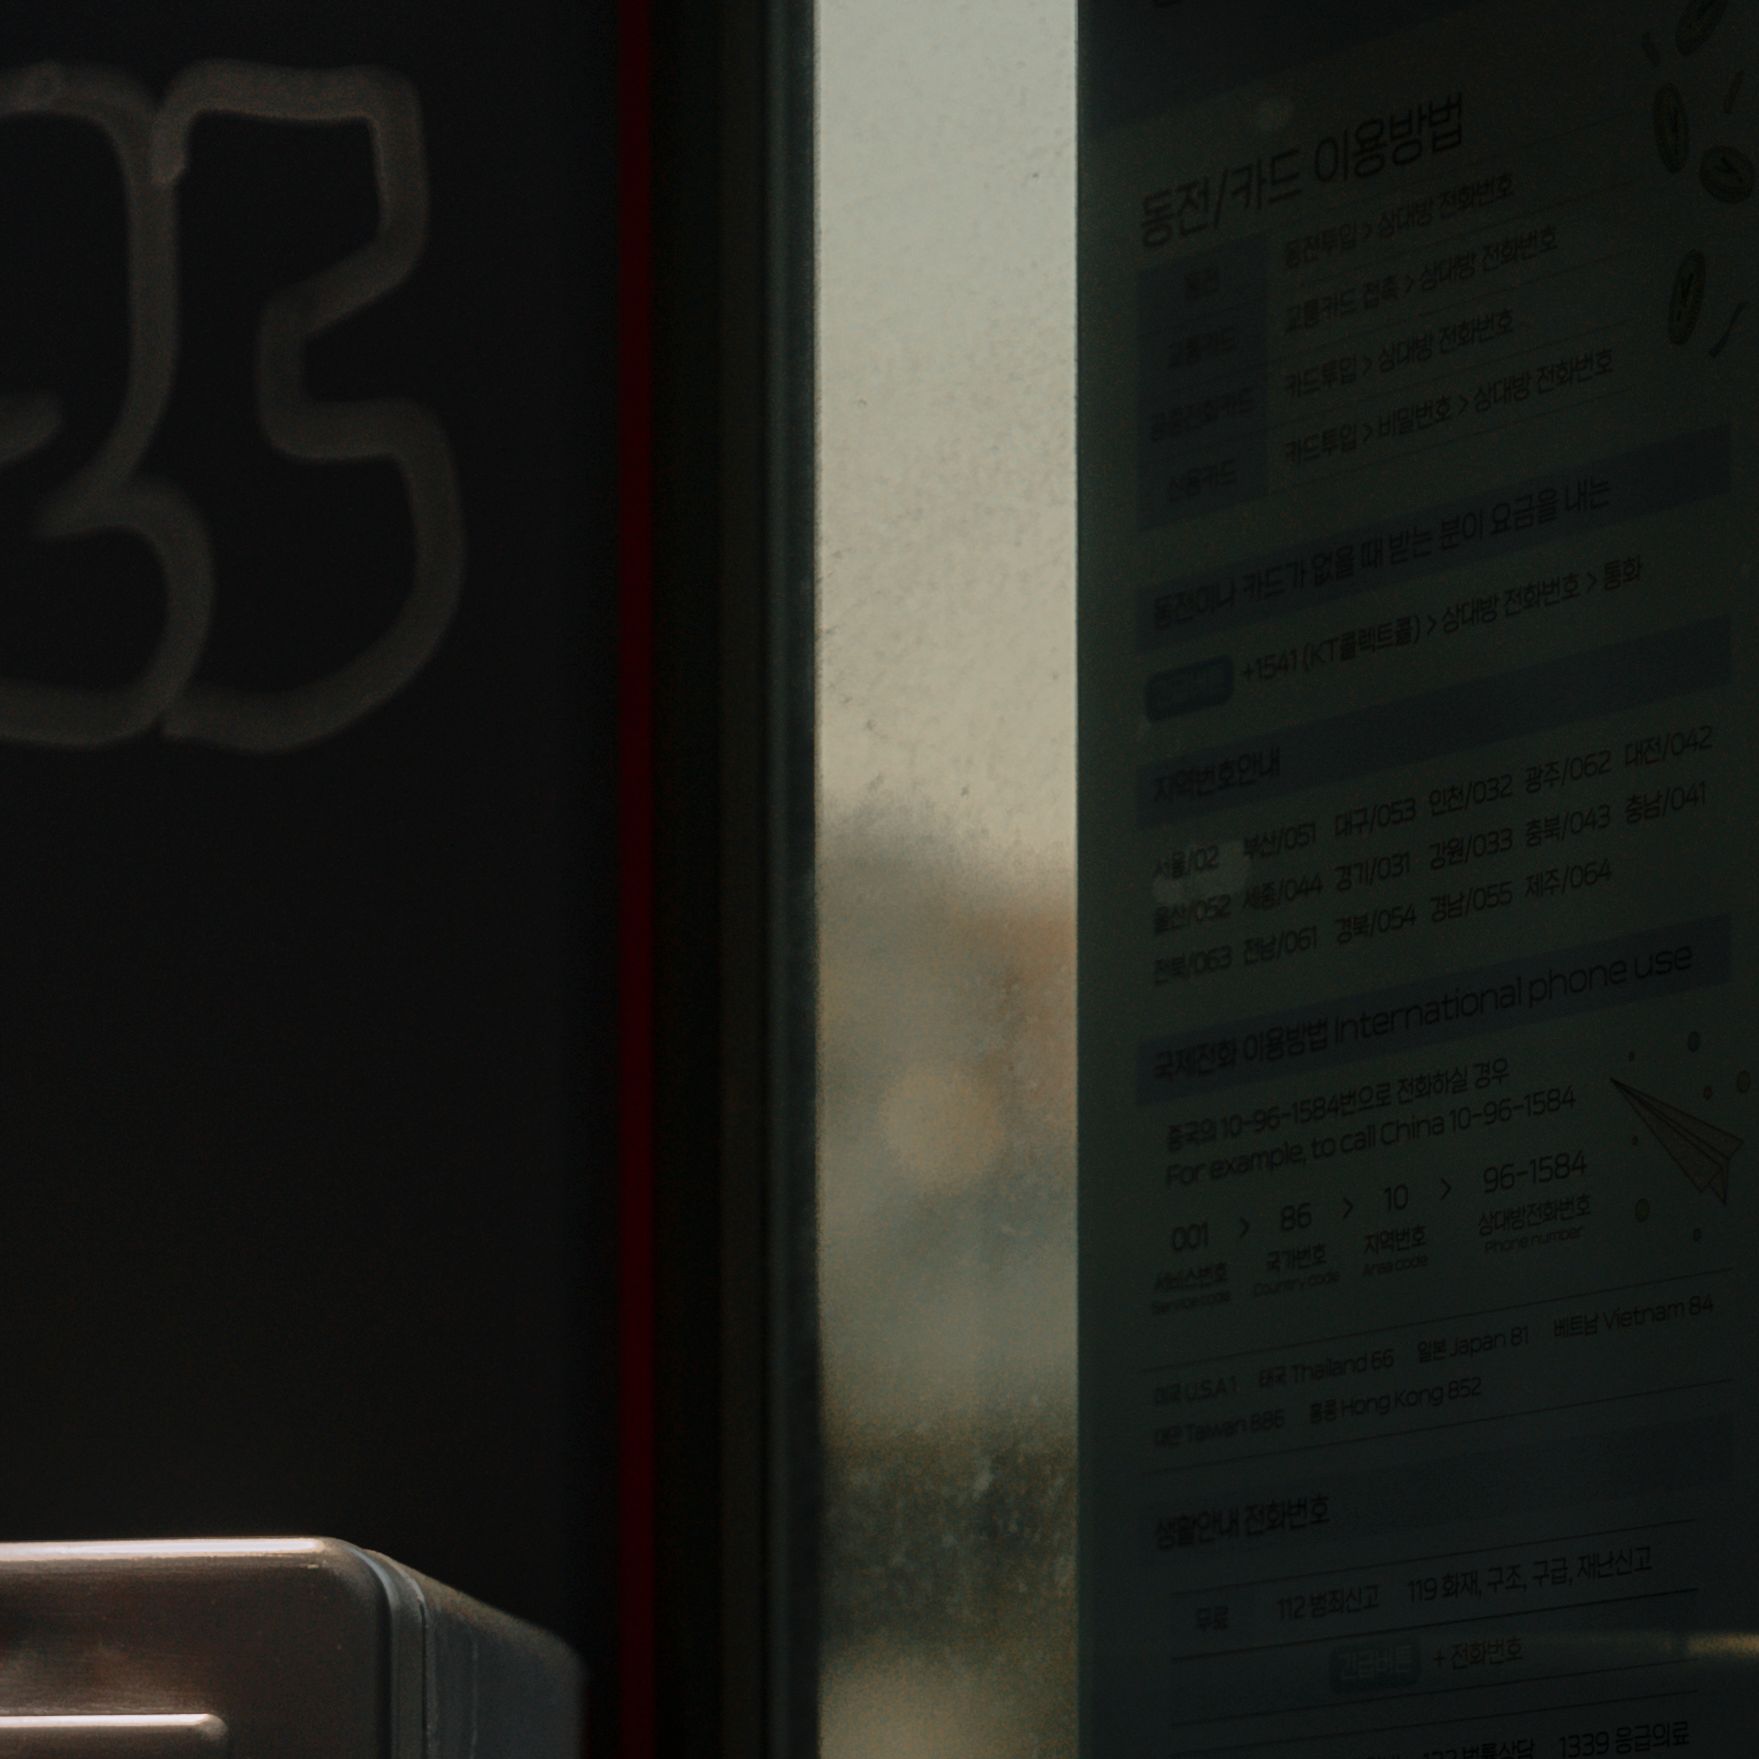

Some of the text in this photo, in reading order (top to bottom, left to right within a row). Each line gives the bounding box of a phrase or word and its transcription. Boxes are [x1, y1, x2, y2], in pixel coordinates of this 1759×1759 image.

[1313, 91, 1463, 183] 이용방법
[1377, 200, 1434, 239] 상대방
[1440, 172, 1515, 220] 전화번호
[1418, 225, 1559, 293] 상대방 전화번호
[1377, 335, 1434, 374] 상대방
[1440, 309, 1515, 353] 전화번호
[1377, 396, 1452, 438] 비밀번호
[1473, 376, 1532, 414] 상대방
[1535, 348, 1614, 394] 전화번호
[1242, 476, 1612, 603] 카드가 없을 때 받는 분이 요금을 내는
[1442, 554, 1643, 634] 상대방 전화번호 통화
[1335, 798, 1417, 838] 대구/053
[1429, 773, 1514, 817] 인천/032
[1525, 750, 1612, 794] 광주/062
[1625, 725, 1714, 767] 대전/042
[1429, 827, 1514, 871] 강원/033
[1525, 858, 1613, 899] 제주/064
[1242, 1018, 1329, 1063] 이용방법
[1334, 974, 1524, 1045] International
[1528, 960, 1628, 1007] phone
[1633, 944, 1694, 982] use
[1397, 1058, 1510, 1105] 전화하실 경우
[1166, 1160, 1208, 1187] For
[1312, 1135, 1336, 1159] to
[1340, 1123, 1376, 1154] call
[1380, 1112, 1446, 1147] China
[1449, 1086, 1576, 1132] 10-96-1584
[1170, 1150, 1589, 1252] 001 86 10 96-1584
[1449, 1330, 1506, 1359] Japan
[1602, 1302, 1685, 1331] Vietnam
[1688, 1294, 1714, 1318] 84
[1340, 1376, 1482, 1420] Hong Kong 852
[1243, 1494, 1330, 1537] 전화번호
[1276, 1595, 1307, 1621] 112
[1408, 1578, 1437, 1603] 119
[1577, 1546, 1652, 1583] 재난신고
[1449, 1635, 1524, 1669] 전화번호
[1558, 1733, 1609, 1759] 1339
[1614, 1721, 1690, 1754] 응급의료
